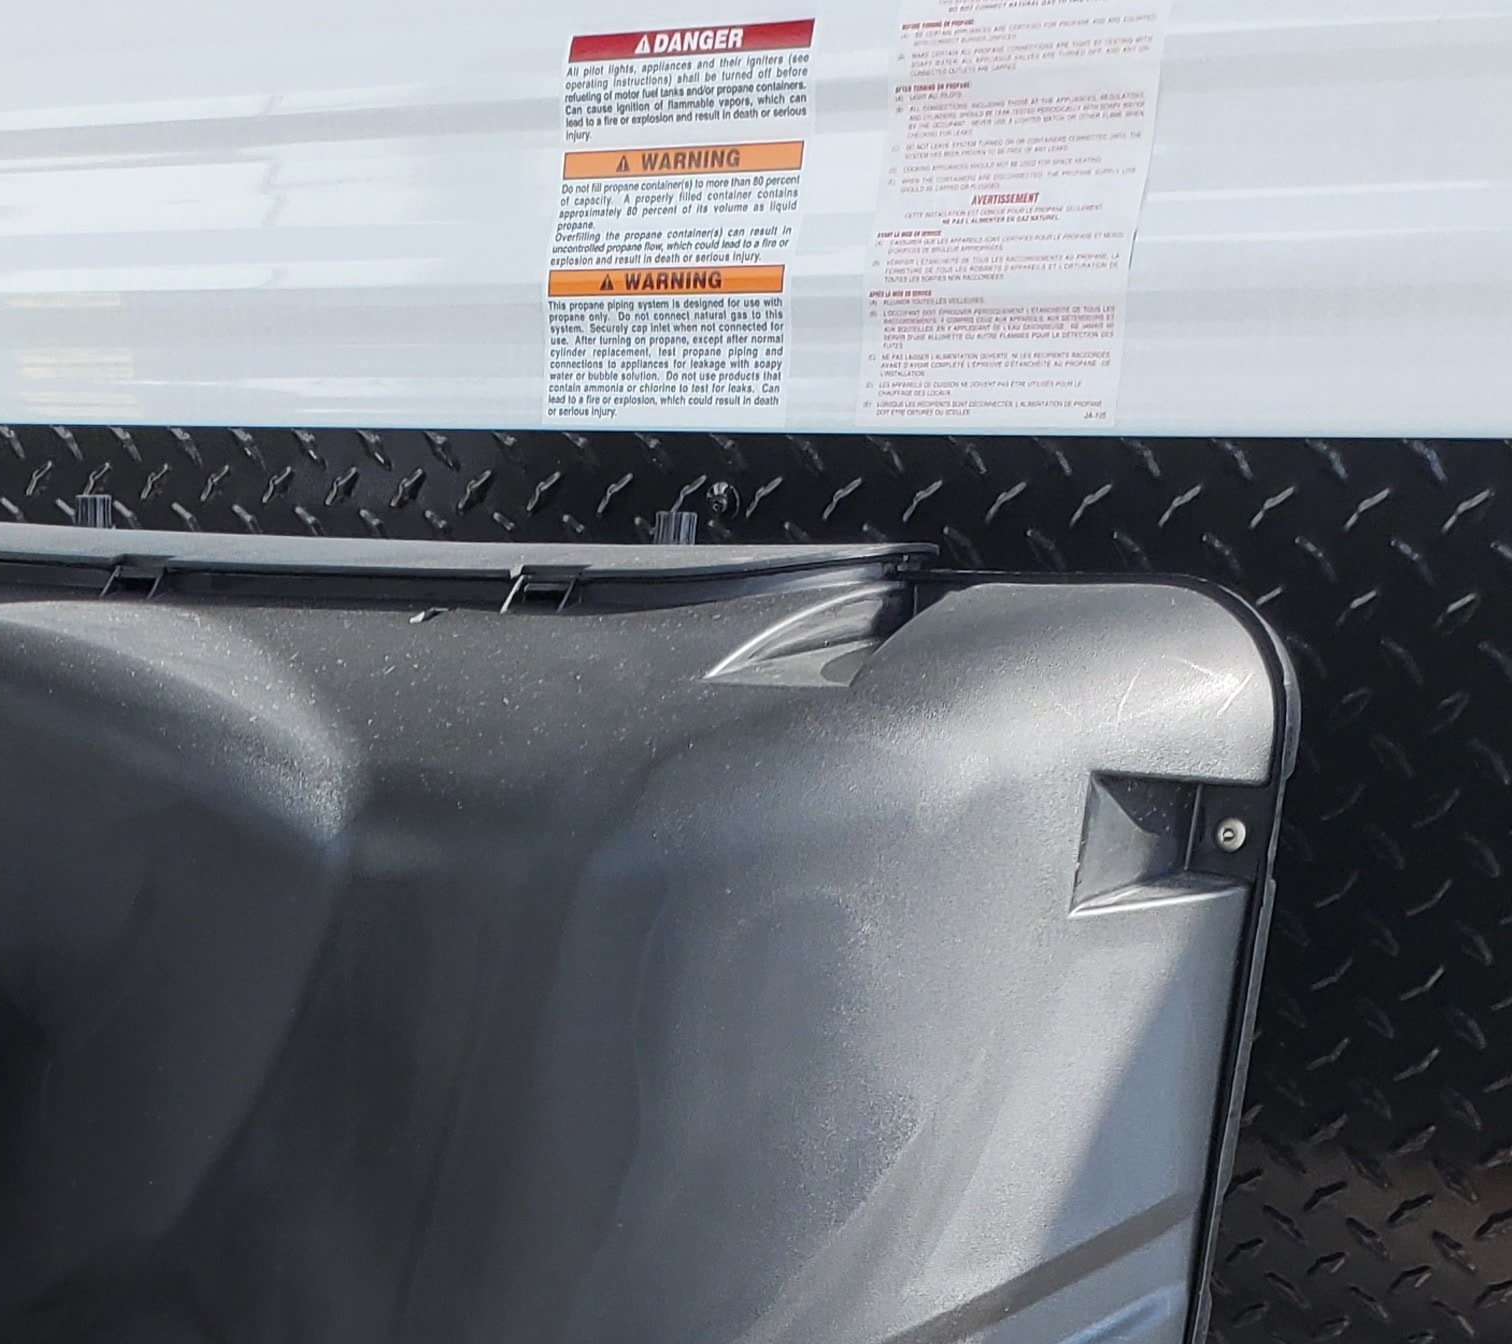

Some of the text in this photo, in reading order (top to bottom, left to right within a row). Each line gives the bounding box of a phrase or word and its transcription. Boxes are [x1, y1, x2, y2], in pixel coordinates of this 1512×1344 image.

[653, 29, 743, 53] DANGER
[566, 52, 809, 78] All pilot lights, appliances and their igniters (see
[565, 67, 808, 91] operating instructions) shall be turned off before
[565, 94, 806, 114] Can cause ignition of flammable vapors, which can
[565, 128, 590, 142] injury.
[641, 150, 741, 171] WARNING
[560, 188, 798, 207] of capacity. A properly filled container contains
[971, 192, 1039, 205] AVERTISSEMENT
[558, 201, 797, 220] approximately 80 percent of its volume as liquid
[557, 222, 595, 232] propane.
[554, 231, 600, 244] Overfilling
[605, 230, 620, 240] the
[623, 231, 662, 242] propane
[666, 227, 723, 240] container(s)
[749, 226, 777, 236] result
[782, 225, 792, 235] in
[625, 271, 722, 290] WARNING
[548, 300, 566, 310] This
[569, 302, 604, 312] propane
[606, 300, 634, 311] piping
[637, 299, 669, 311] system
[672, 299, 680, 308] is
[683, 298, 724, 310] designed
[727, 298, 740, 308] for
[762, 297, 782, 307] with
[548, 310, 783, 323] propane only. Do not connect natural gas to this
[550, 322, 784, 334] system. Securely cap inlet when not connected for
[574, 335, 596, 345] After
[599, 335, 631, 347] turning
[648, 336, 689, 346] propane,
[692, 334, 723, 346] except
[726, 334, 748, 343] after
[750, 333, 783, 343] normal
[549, 346, 783, 358] cylinder replacement, test propane piping and
[549, 358, 782, 370] connections to appliances for leakage with soapy
[549, 370, 573, 380] water
[587, 370, 618, 380] bubble
[620, 371, 659, 380] solution.
[665, 371, 678, 380] Do
[681, 371, 696, 380] not
[718, 371, 760, 382] products
[762, 371, 781, 380] that
[548, 383, 580, 392] contain
[583, 383, 624, 392] ammonia
[639, 383, 676, 392] chlorine
[679, 383, 688, 392] to
[691, 383, 708, 392] test
[711, 383, 725, 392] for
[727, 383, 754, 392] leaks.
[761, 383, 780, 392] Can
[558, 406, 589, 416] serious
[591, 406, 616, 418] injury.
